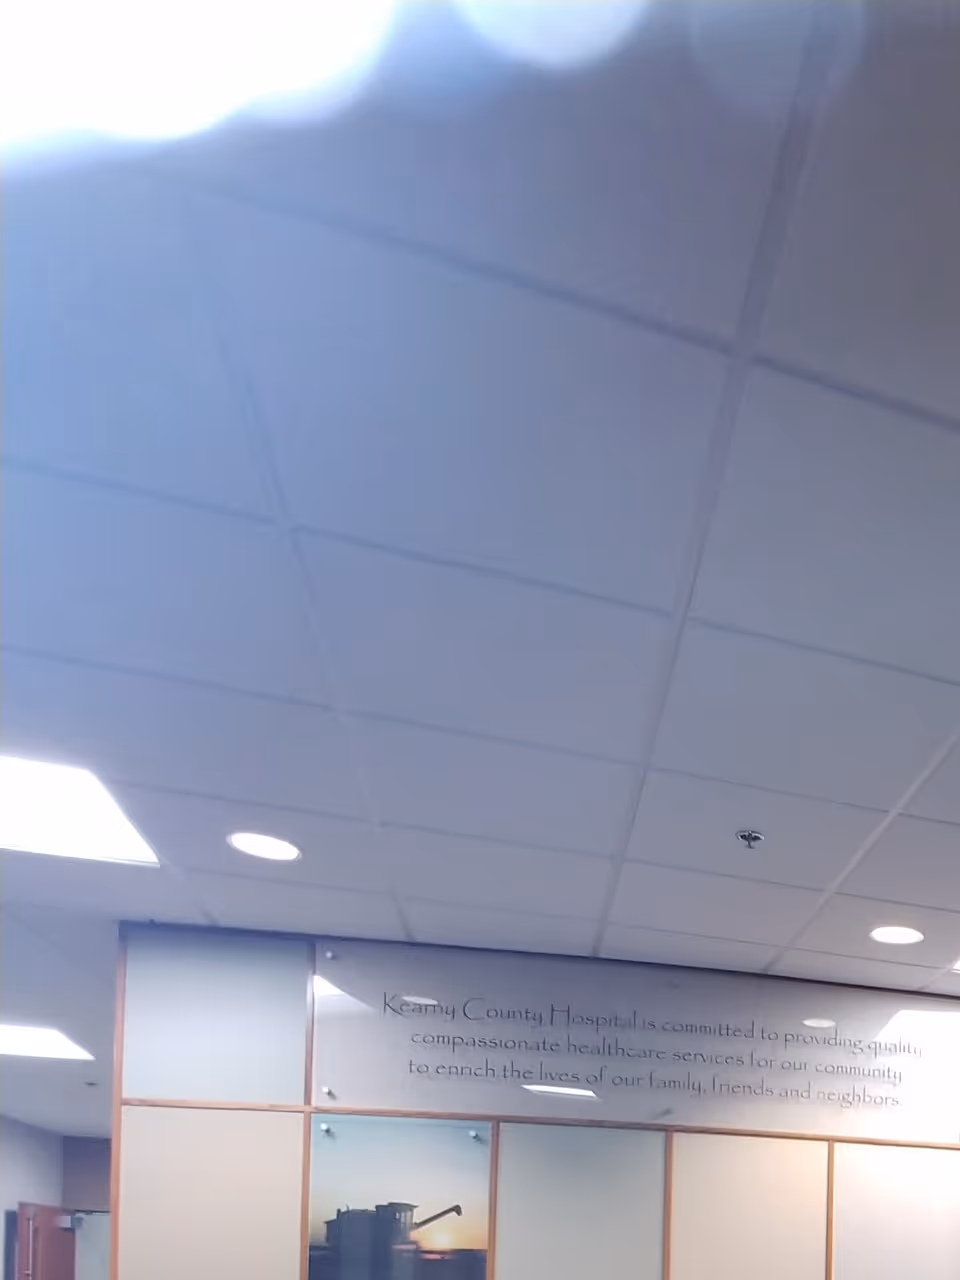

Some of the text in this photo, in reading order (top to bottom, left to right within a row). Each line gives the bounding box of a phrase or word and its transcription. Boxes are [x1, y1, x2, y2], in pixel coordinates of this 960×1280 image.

[383, 991, 922, 1058] Kearny County Hospital is committed to providing quality
[408, 1058, 429, 1074] to
[435, 1058, 496, 1079] enrich
[503, 1060, 534, 1081] the
[540, 1061, 580, 1084] lives
[585, 1064, 608, 1085] of
[612, 1074, 642, 1088] our
[712, 1074, 773, 1098] friends
[779, 1080, 811, 1101] and
[411, 1031, 902, 1086] compassionate healthcare services for our community
